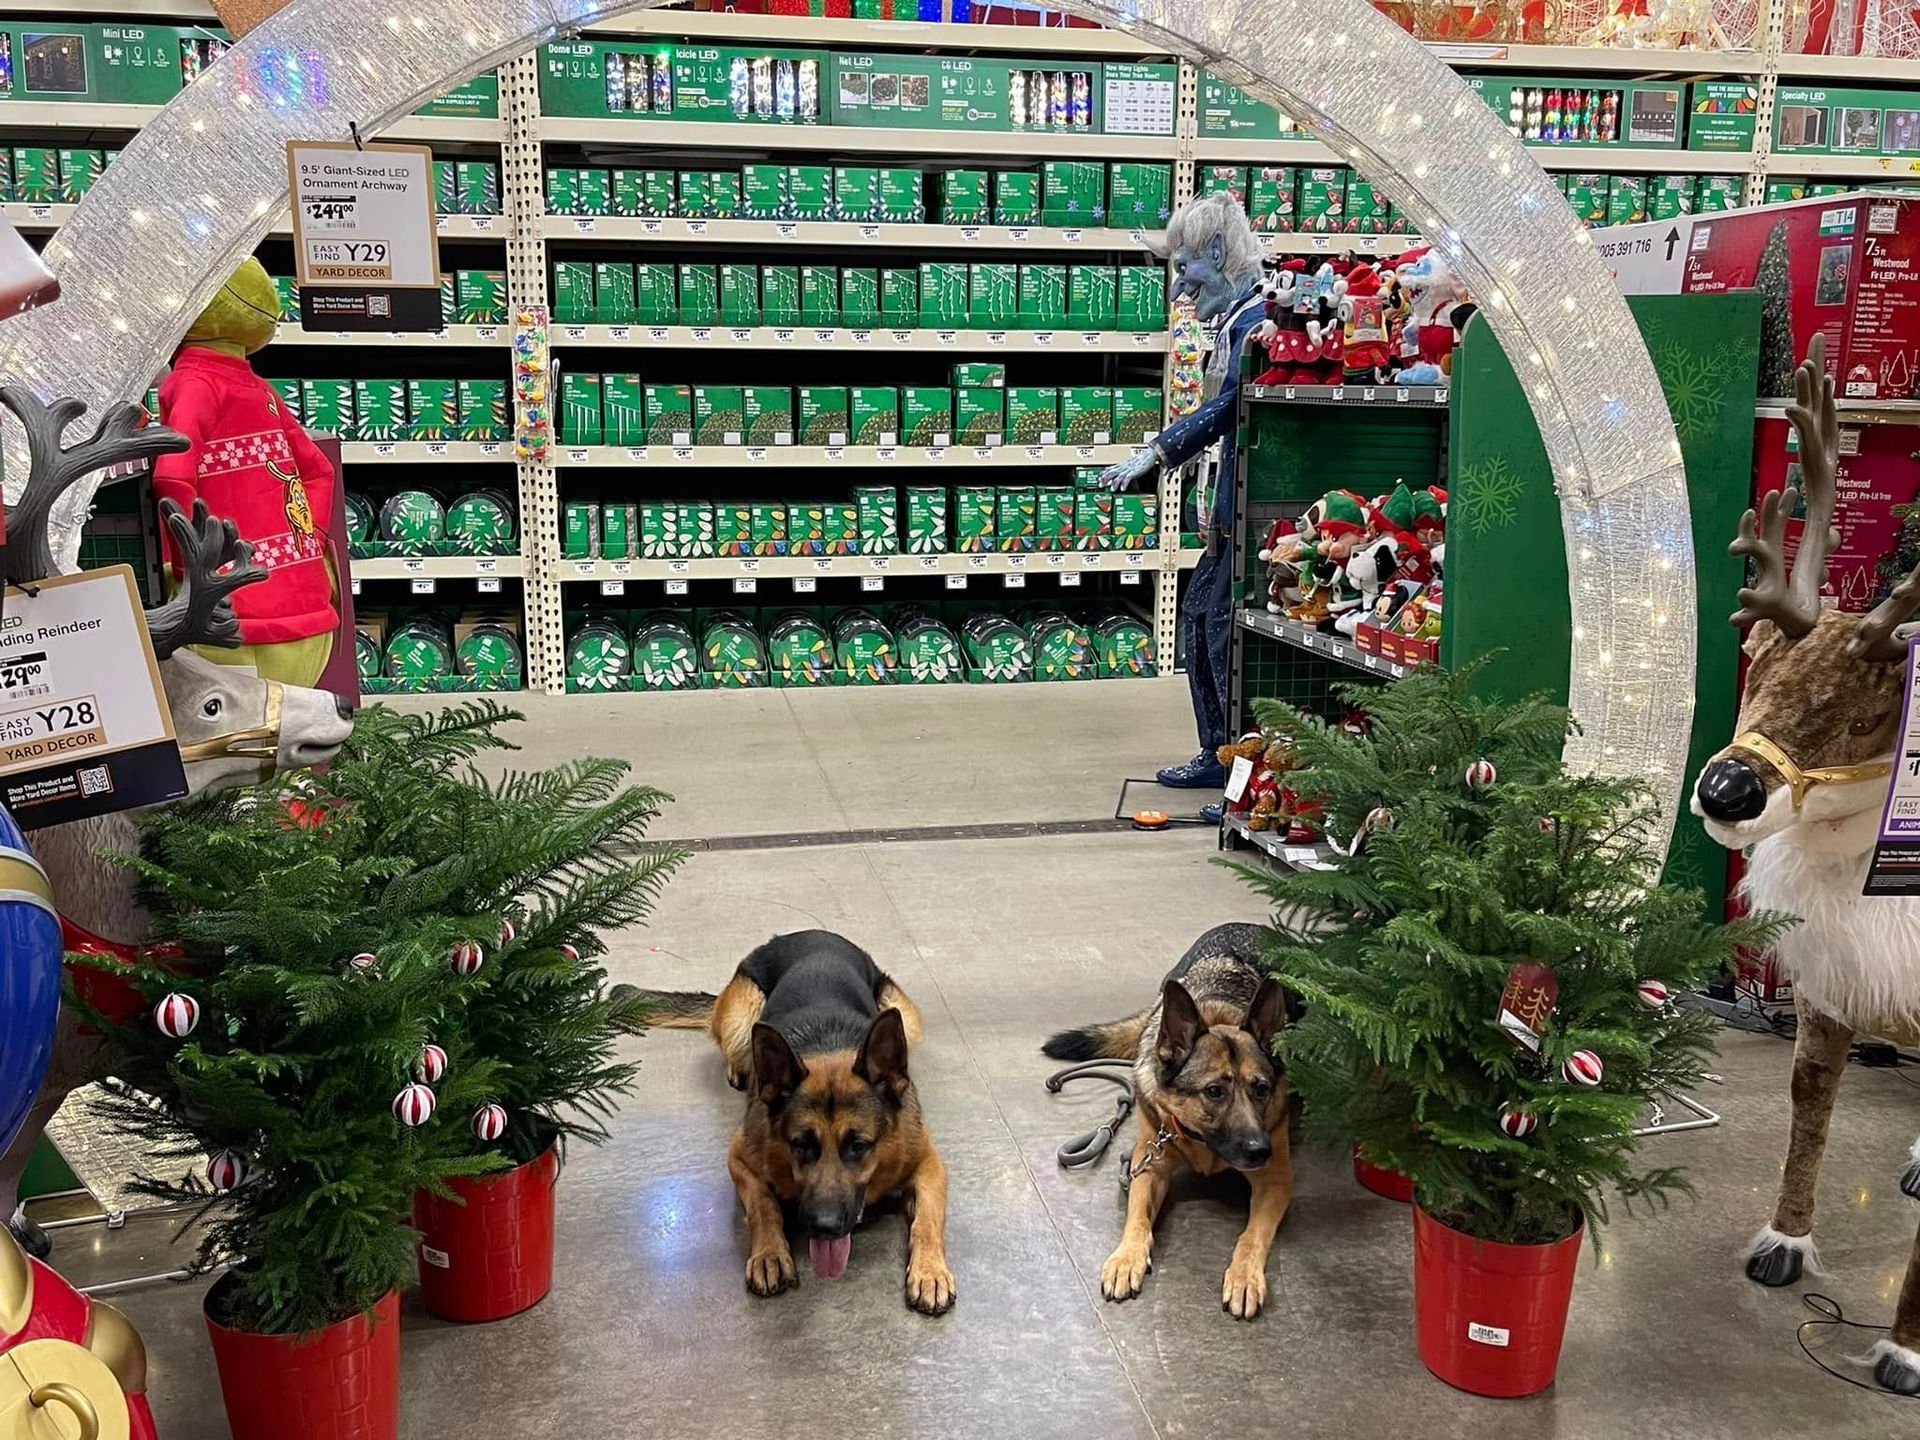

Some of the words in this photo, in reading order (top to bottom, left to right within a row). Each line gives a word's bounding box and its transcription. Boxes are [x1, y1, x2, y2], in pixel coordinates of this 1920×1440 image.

[103, 28, 120, 39] Mini
[122, 29, 144, 39] LED
[548, 43, 571, 54] Dome
[572, 45, 593, 55] LED
[676, 49, 697, 59] Icicle
[698, 50, 719, 60] LED
[839, 56, 852, 66] Net
[853, 57, 873, 67] LED
[952, 61, 972, 71] LED
[1781, 90, 1809, 102] Specialty
[1809, 91, 1826, 101] LED
[301, 164, 320, 175] 9.5'
[323, 165, 386, 177] Giant-Sized
[388, 167, 409, 178] LED
[303, 178, 359, 190] Ornament
[360, 180, 408, 192] Archway
[1836, 209, 1853, 224] T14
[313, 245, 340, 253] EASY
[344, 243, 386, 262] Y29
[1616, 241, 1632, 256] 391
[1635, 238, 1652, 254] 716
[314, 252, 340, 261] FIND
[1872, 257, 1910, 269] Westwood
[316, 267, 345, 277] YARD
[348, 268, 385, 278] DECOR
[1879, 271, 1896, 280] LED
[1836, 478, 1871, 489] Westwood
[1842, 492, 1858, 500] LED
[37, 618, 102, 639] Reindeer
[35, 701, 95, 732] Y28
[0, 727, 34, 742] FIND
[5, 744, 43, 761] YARD
[47, 733, 98, 752] DECOR
[7, 787, 24, 796] Shop
[37, 778, 61, 789] Product
[61, 775, 74, 783] and
[9, 794, 26, 803] More
[26, 790, 40, 799] Yard
[41, 787, 58, 796] Decor
